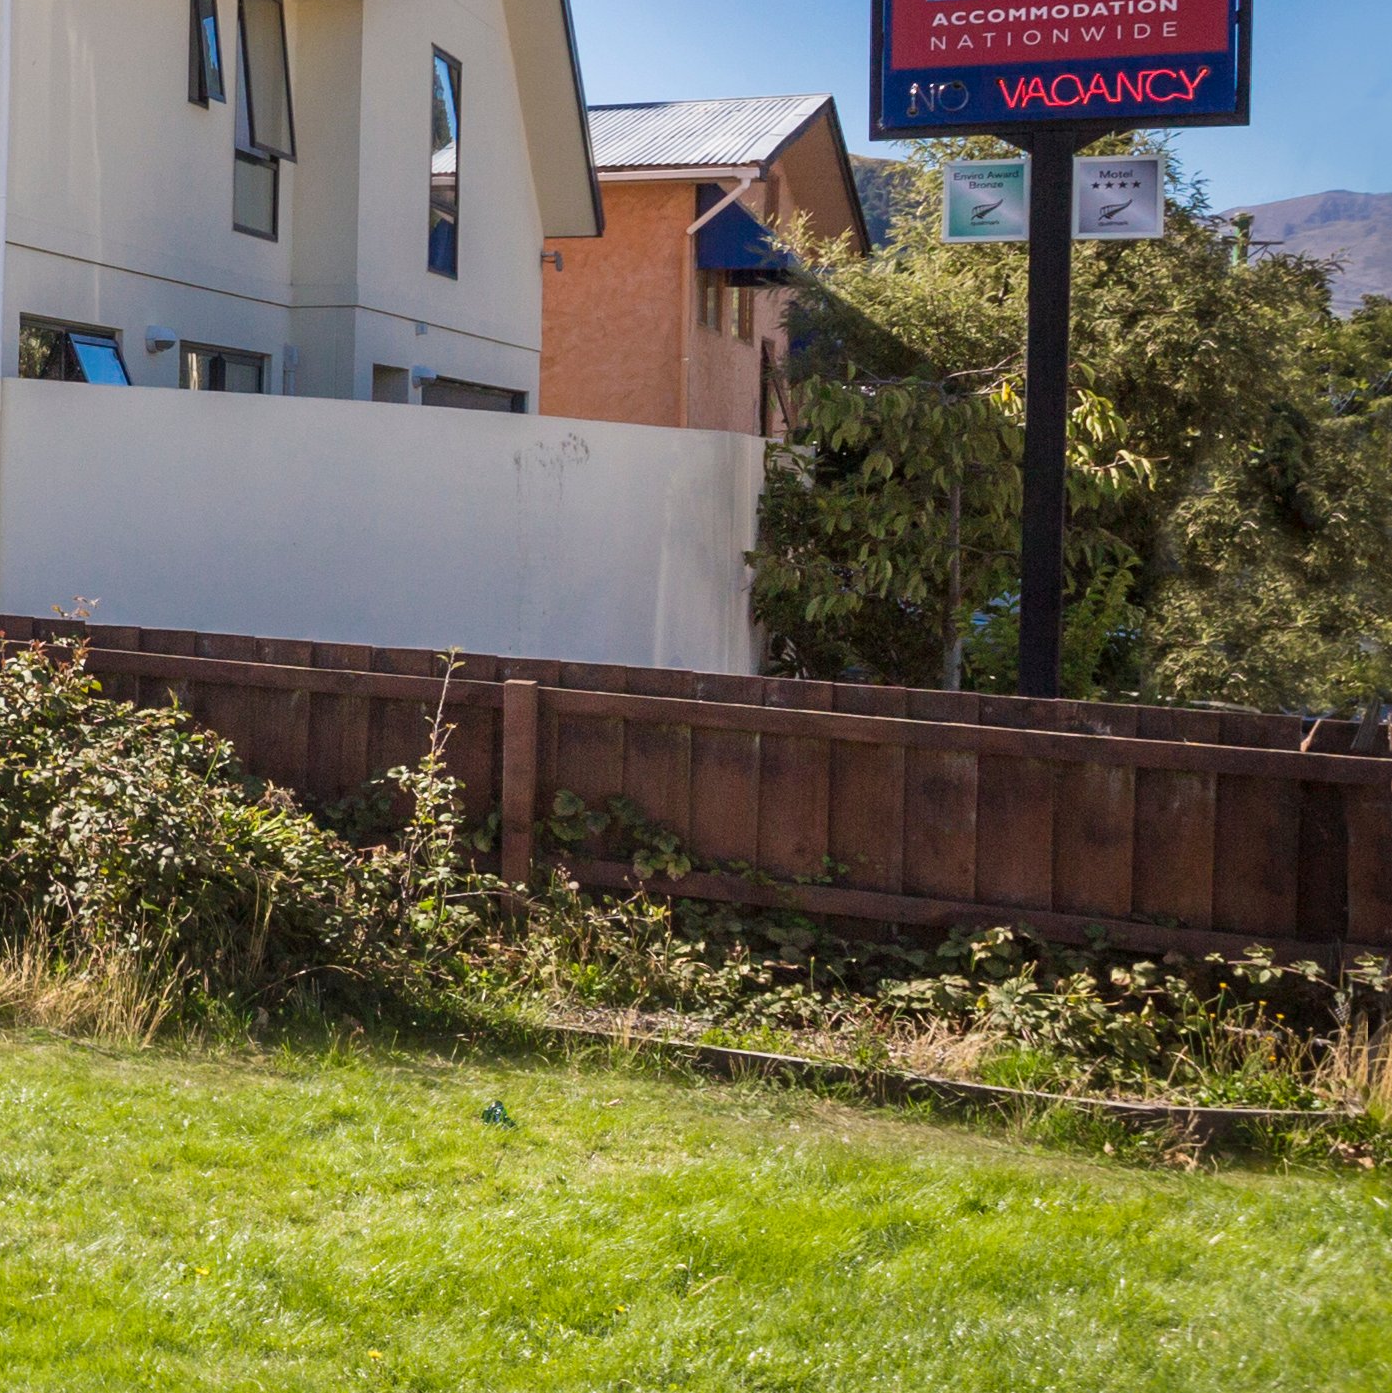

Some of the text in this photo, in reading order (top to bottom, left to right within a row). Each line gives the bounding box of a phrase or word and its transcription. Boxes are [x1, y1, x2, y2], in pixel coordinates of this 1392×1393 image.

[930, 21, 1177, 51] NATIONWIDE
[907, 68, 1209, 115] NO VACANCY
[953, 169, 1019, 181] Enviro Award
[1099, 169, 1134, 179] Motel
[968, 180, 1004, 190] Bronze
